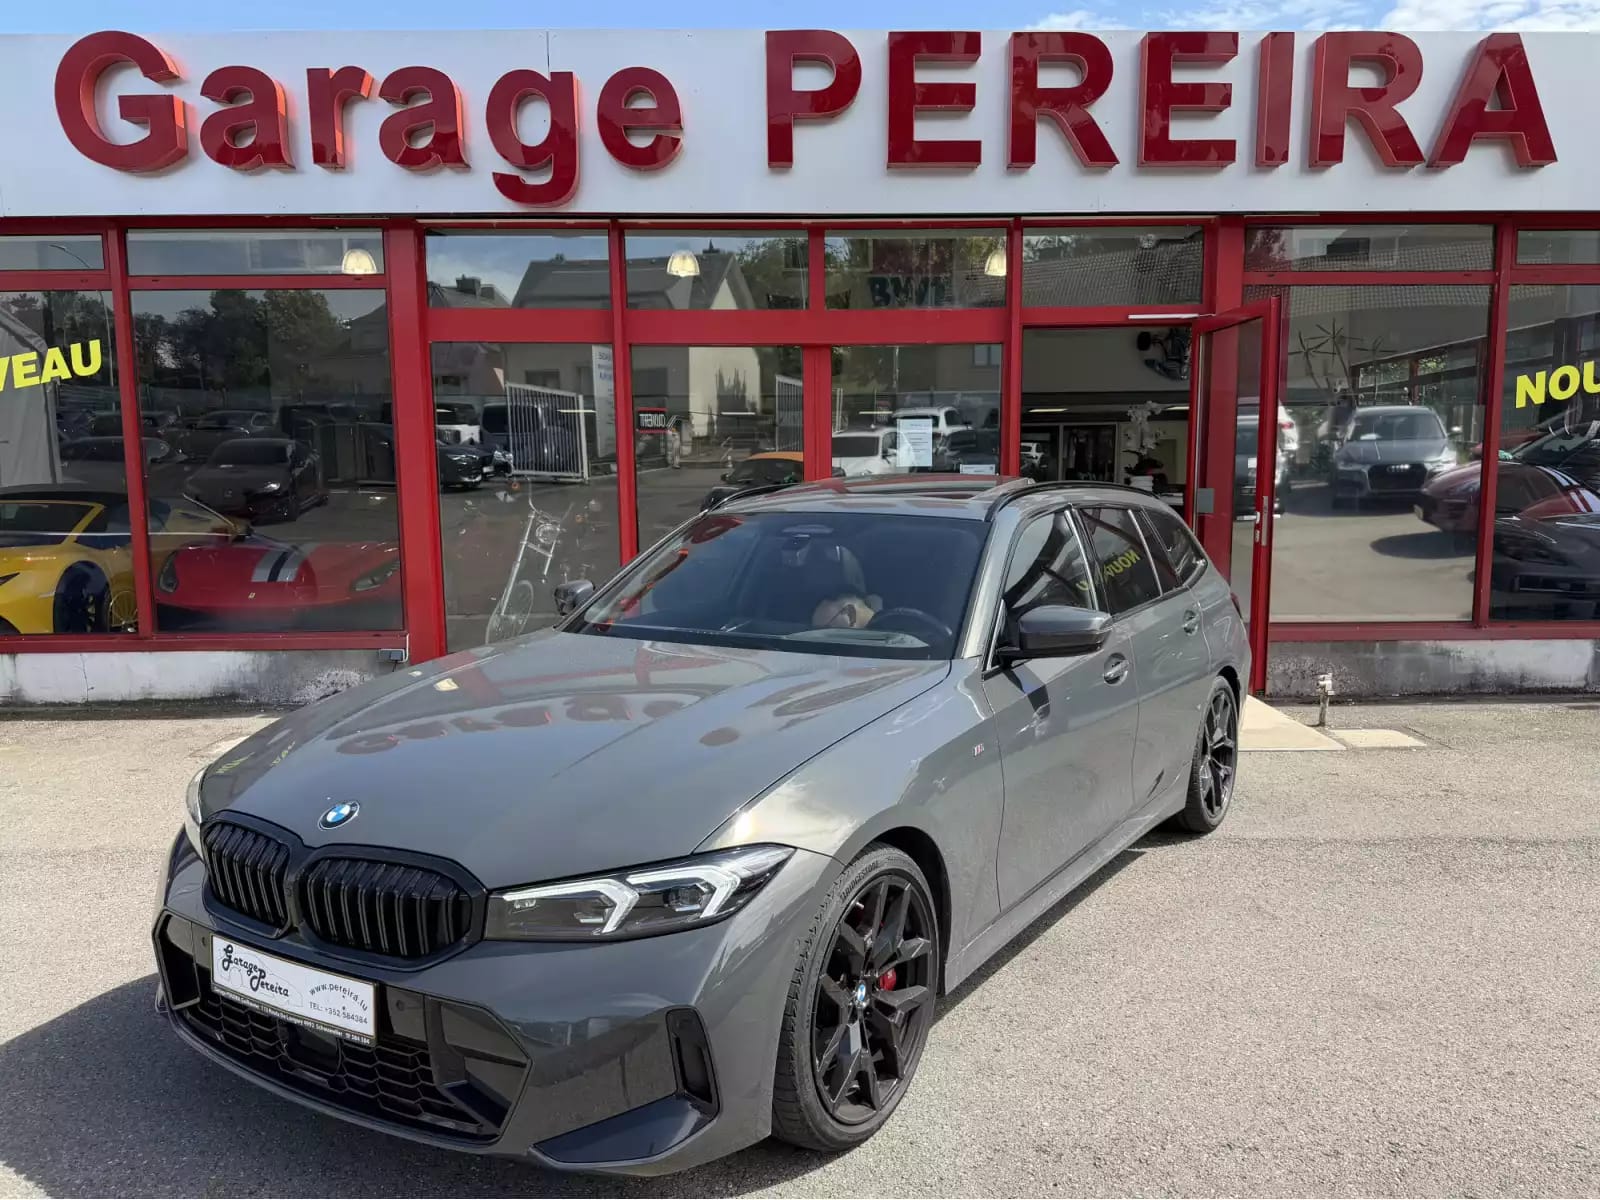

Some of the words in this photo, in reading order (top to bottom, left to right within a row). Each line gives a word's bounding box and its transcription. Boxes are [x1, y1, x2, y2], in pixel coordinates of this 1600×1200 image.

[55, 30, 684, 207] Garage
[765, 30, 1557, 169] PEREIRA
[222, 944, 258, 976] Garage
[250, 968, 289, 997] Pereira
[309, 984, 368, 1011] www.pereira.lu
